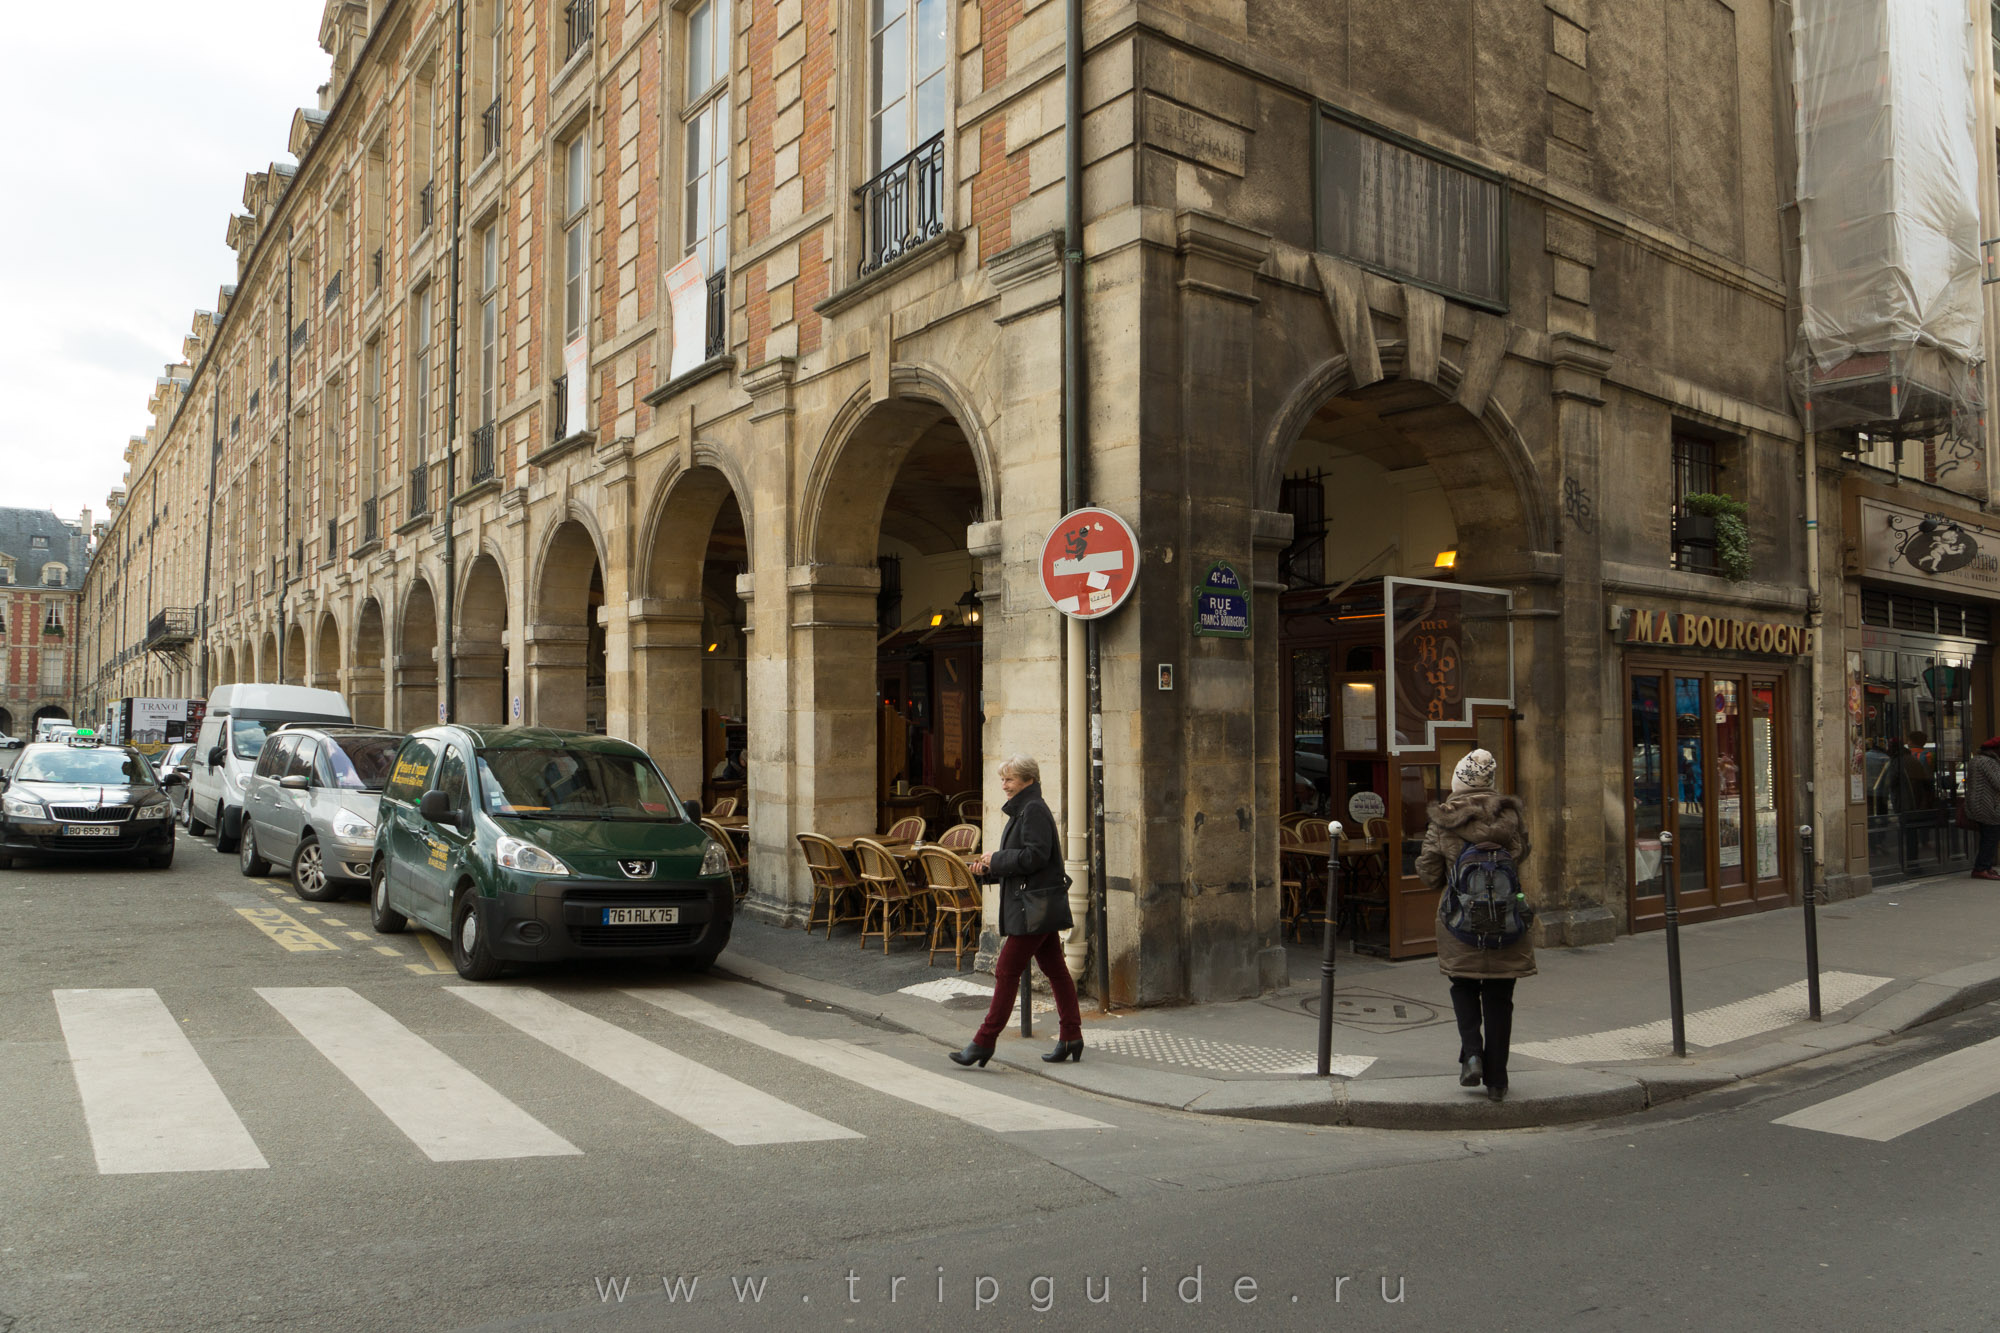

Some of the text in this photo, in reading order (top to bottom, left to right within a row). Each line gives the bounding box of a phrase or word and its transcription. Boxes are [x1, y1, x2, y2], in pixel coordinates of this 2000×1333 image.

[1178, 111, 1204, 133] RUE
[1209, 597, 1232, 610] RUE
[1200, 613, 1246, 628] FRANCS BOURGEOIS
[1420, 618, 1448, 630] ma
[1634, 608, 1675, 645] MA
